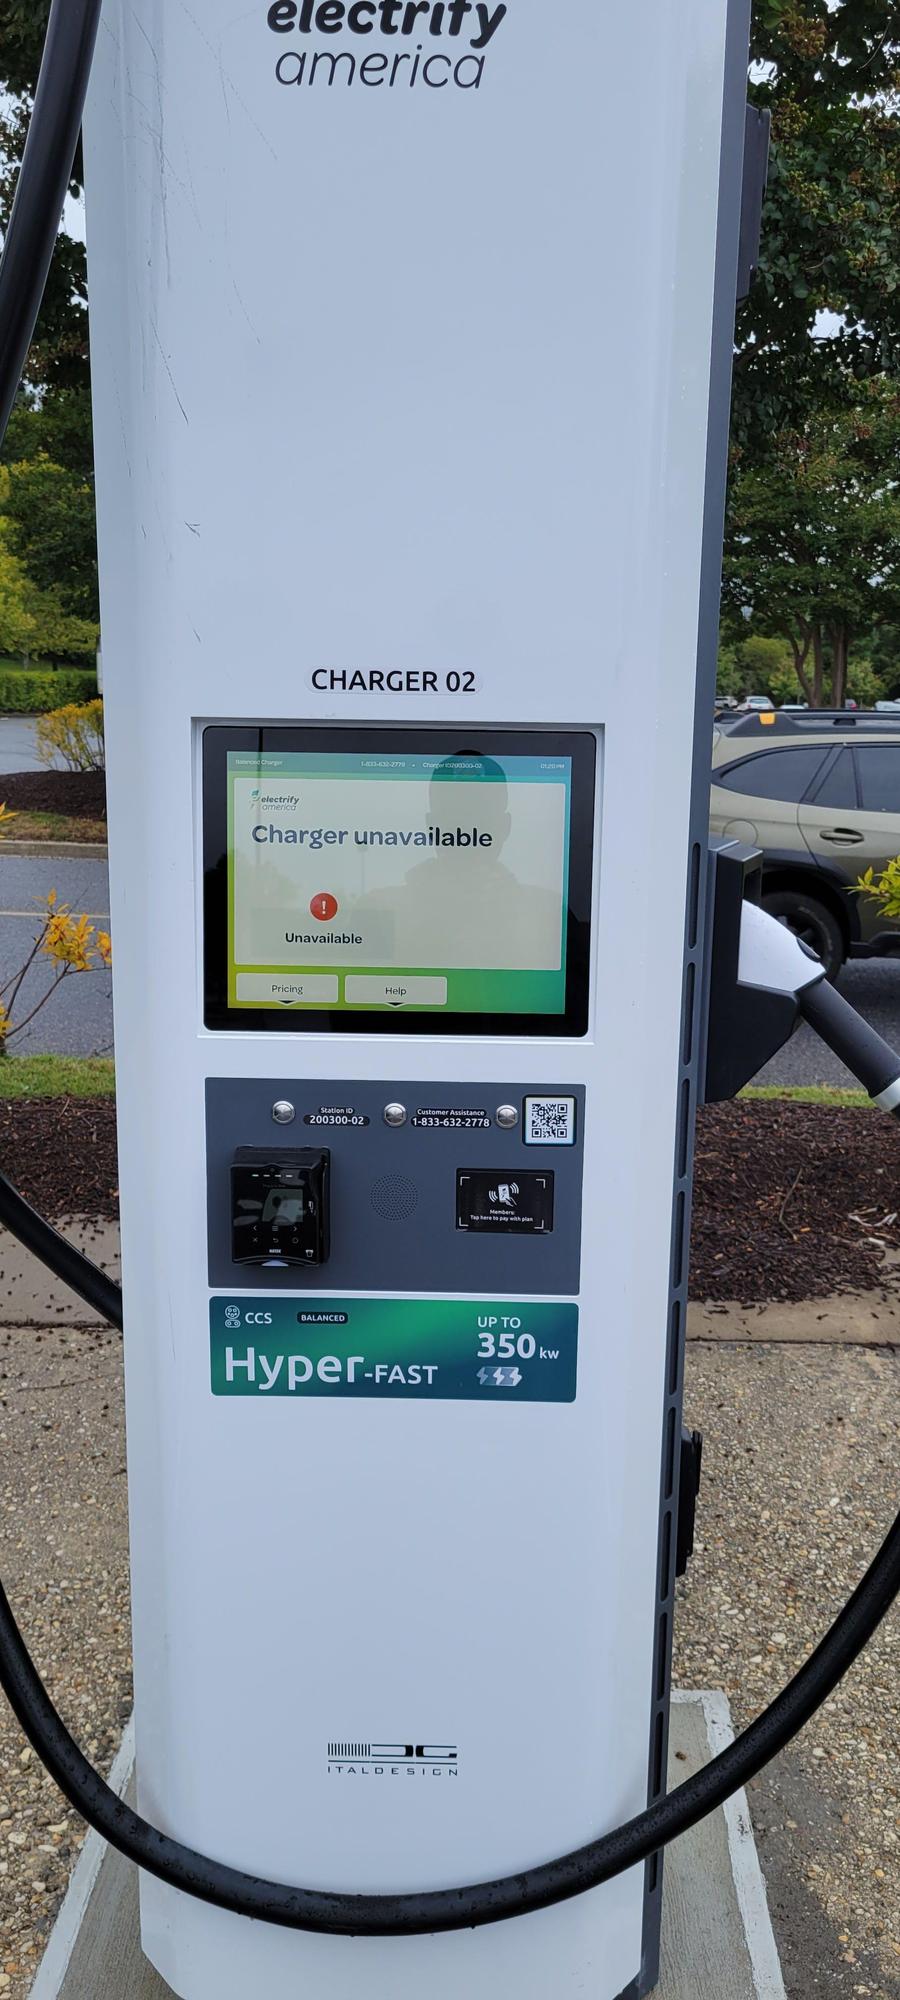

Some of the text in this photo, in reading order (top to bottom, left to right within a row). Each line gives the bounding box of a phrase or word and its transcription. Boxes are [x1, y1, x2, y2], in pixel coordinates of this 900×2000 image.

[266, 0, 507, 49] electrify
[275, 44, 486, 89] america
[311, 668, 476, 692] CHARGER 02
[261, 795, 300, 805] electrify
[262, 803, 297, 811] america
[251, 824, 493, 850] Charger unavailable
[285, 932, 363, 944] Unavailable
[271, 984, 304, 995] Pricing
[385, 986, 407, 996] Help
[309, 1115, 364, 1125] 200300-02
[412, 1117, 490, 1127] 1-833-632-2778
[244, 1312, 272, 1325] CCS
[300, 1314, 346, 1322] BALANCED
[478, 1316, 521, 1329] UP TO
[477, 1332, 536, 1359] 350
[328, 1766, 458, 1776] ITALDESIGN
